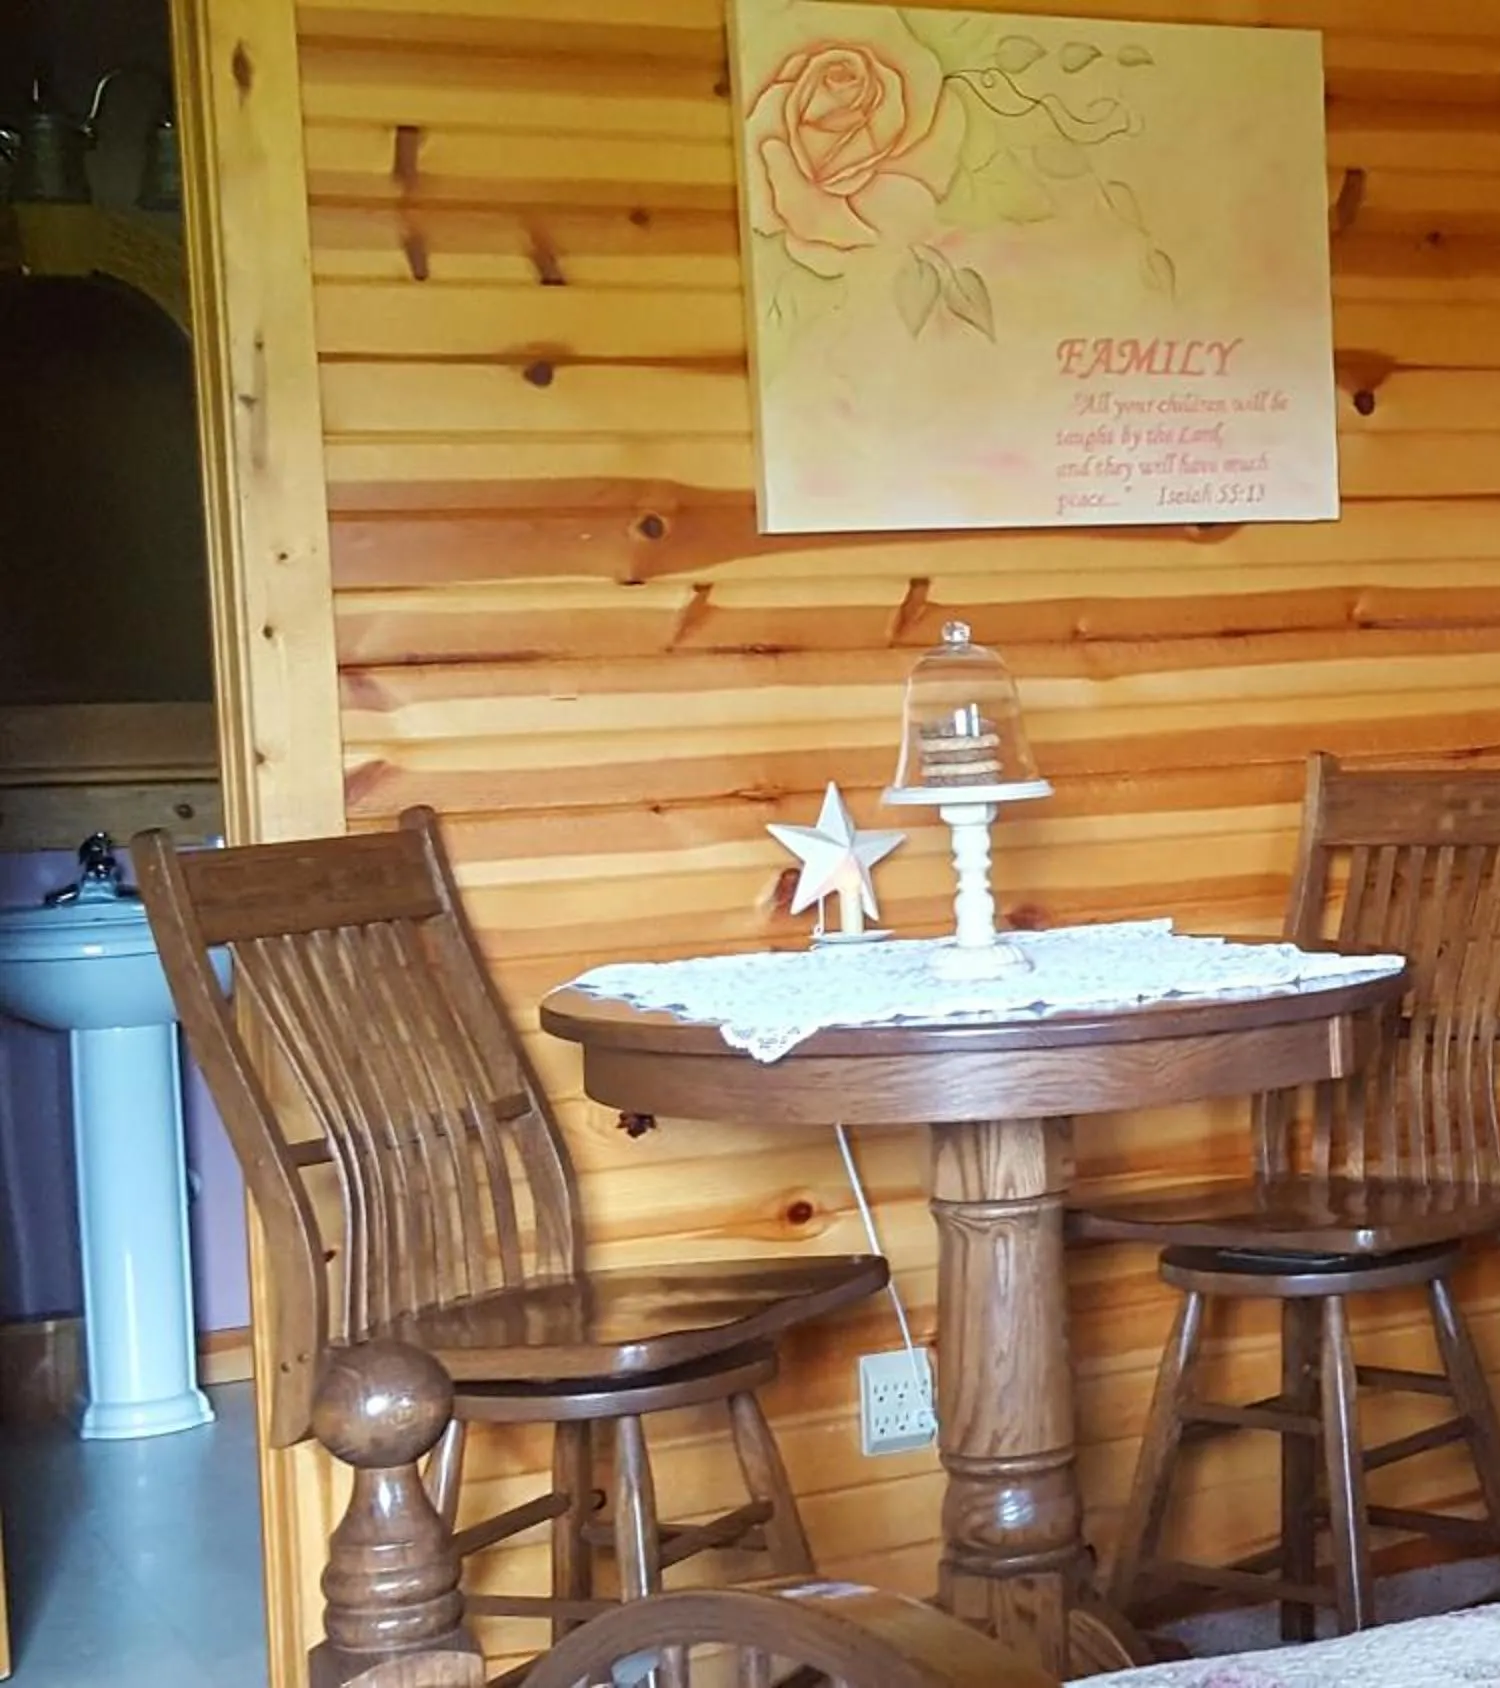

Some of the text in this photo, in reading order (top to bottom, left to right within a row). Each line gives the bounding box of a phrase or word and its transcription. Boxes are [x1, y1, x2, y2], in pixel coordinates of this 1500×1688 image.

[1056, 337, 1244, 379] FAMILY
[1113, 399, 1153, 420] your
[1156, 391, 1227, 414] children
[1230, 389, 1270, 413] will
[1271, 389, 1289, 412] be
[1055, 424, 1113, 452] taught
[1121, 424, 1140, 452] by
[1145, 425, 1173, 446] the
[1056, 451, 1270, 482] and they will have much
